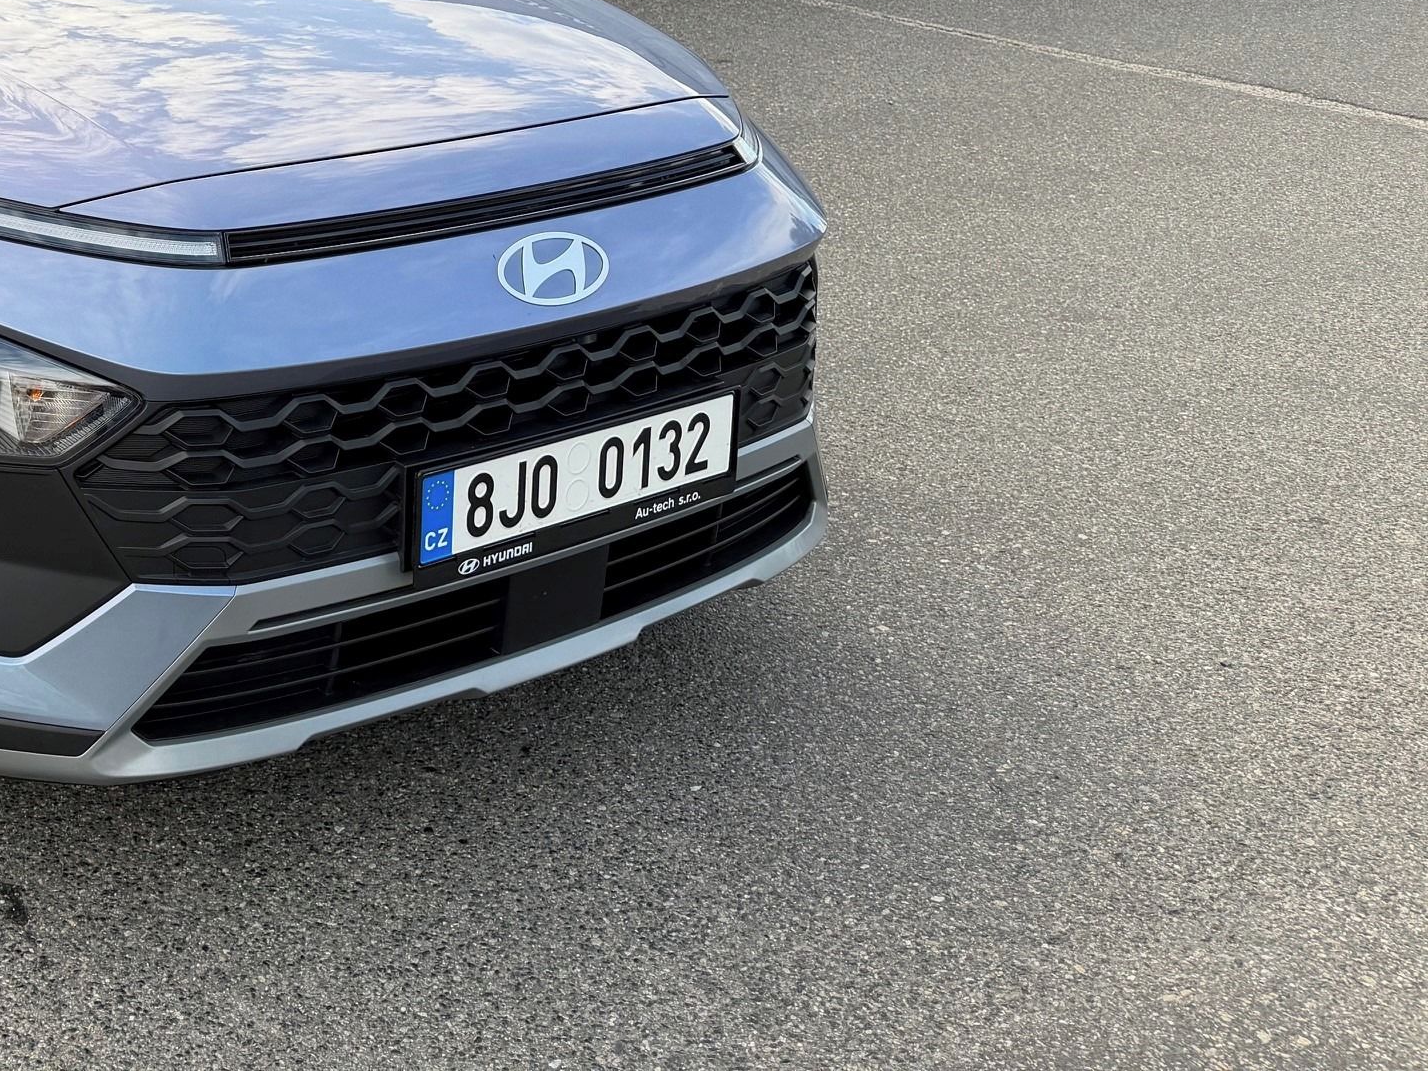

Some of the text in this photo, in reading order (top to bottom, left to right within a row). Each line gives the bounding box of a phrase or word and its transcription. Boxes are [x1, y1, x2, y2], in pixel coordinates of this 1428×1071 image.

[598, 412, 711, 499] 0132
[635, 491, 701, 520] Au-tech s.r.o.
[424, 527, 449, 551] CZ
[483, 541, 533, 568] HYUNDAI
